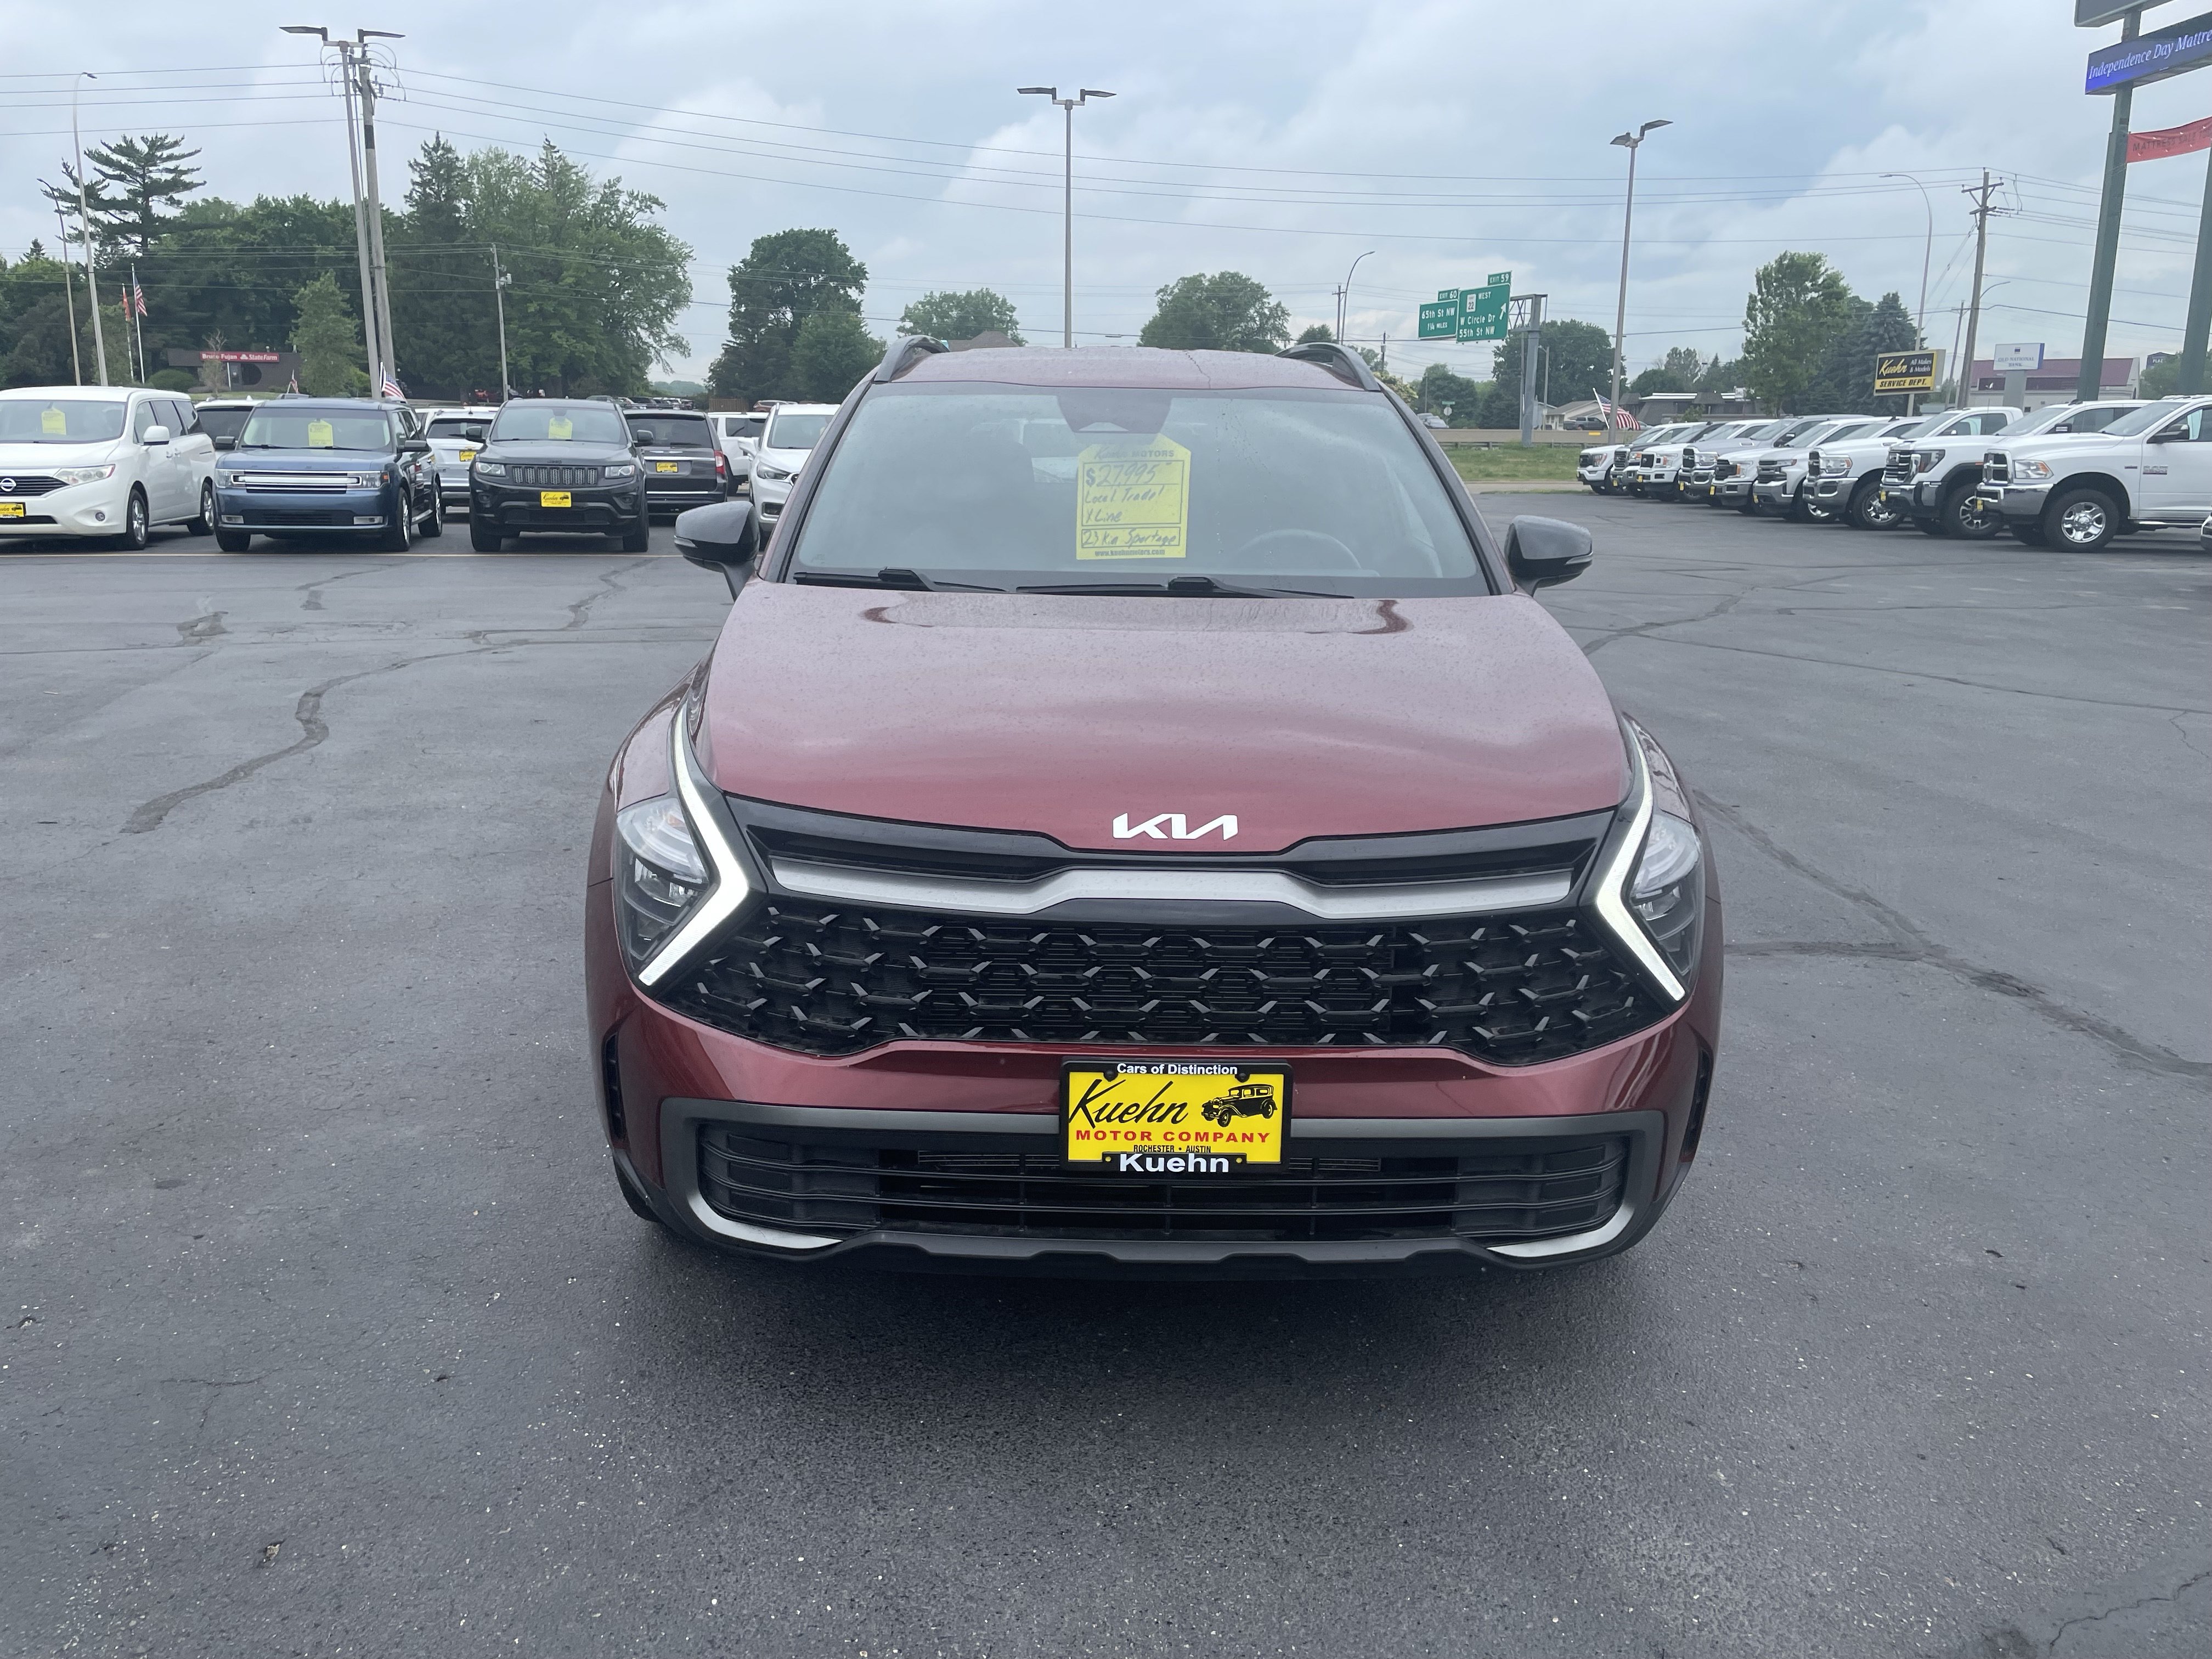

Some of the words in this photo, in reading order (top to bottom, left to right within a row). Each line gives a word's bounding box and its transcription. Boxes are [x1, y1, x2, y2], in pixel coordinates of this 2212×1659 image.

[2088, 49, 2152, 80] Independence
[2152, 42, 2174, 60] Day
[2132, 137, 2175, 151] MATTRESS
[1500, 274, 1509, 283] 59
[1449, 290, 1457, 298] 60
[1479, 291, 1491, 300] WEST
[1468, 302, 1474, 310] 22
[1422, 310, 1435, 319] 65th
[1438, 309, 1444, 317] St
[1446, 307, 1455, 317] NW
[1460, 317, 1465, 326] W
[1468, 315, 1485, 325] Circle
[1488, 313, 1496, 323] Dr
[1459, 328, 1474, 338] 55th
[1476, 328, 1483, 336] St
[1485, 326, 1495, 335] NW
[1879, 358, 1908, 376] Kuehn
[1880, 379, 1908, 387] SERVICE
[1132, 449, 1174, 458] MOTORS
[1085, 489, 1116, 504] Local
[1102, 531, 1119, 545] Kia
[1125, 528, 1176, 549] Sportage
[1113, 812, 1238, 840] KIA
[1116, 1063, 1147, 1075] Cars
[1150, 1063, 1165, 1074] of
[1167, 1063, 1238, 1075] Distinction
[1069, 1079, 1189, 1129] Kuehn
[1076, 1130, 1152, 1141] MOTOR
[1163, 1131, 1271, 1143] COMPANY
[1133, 1144, 1175, 1153] ROCHESTER
[1186, 1145, 1211, 1153] AUSTIN
[1119, 1153, 1229, 1173] Kuehn
